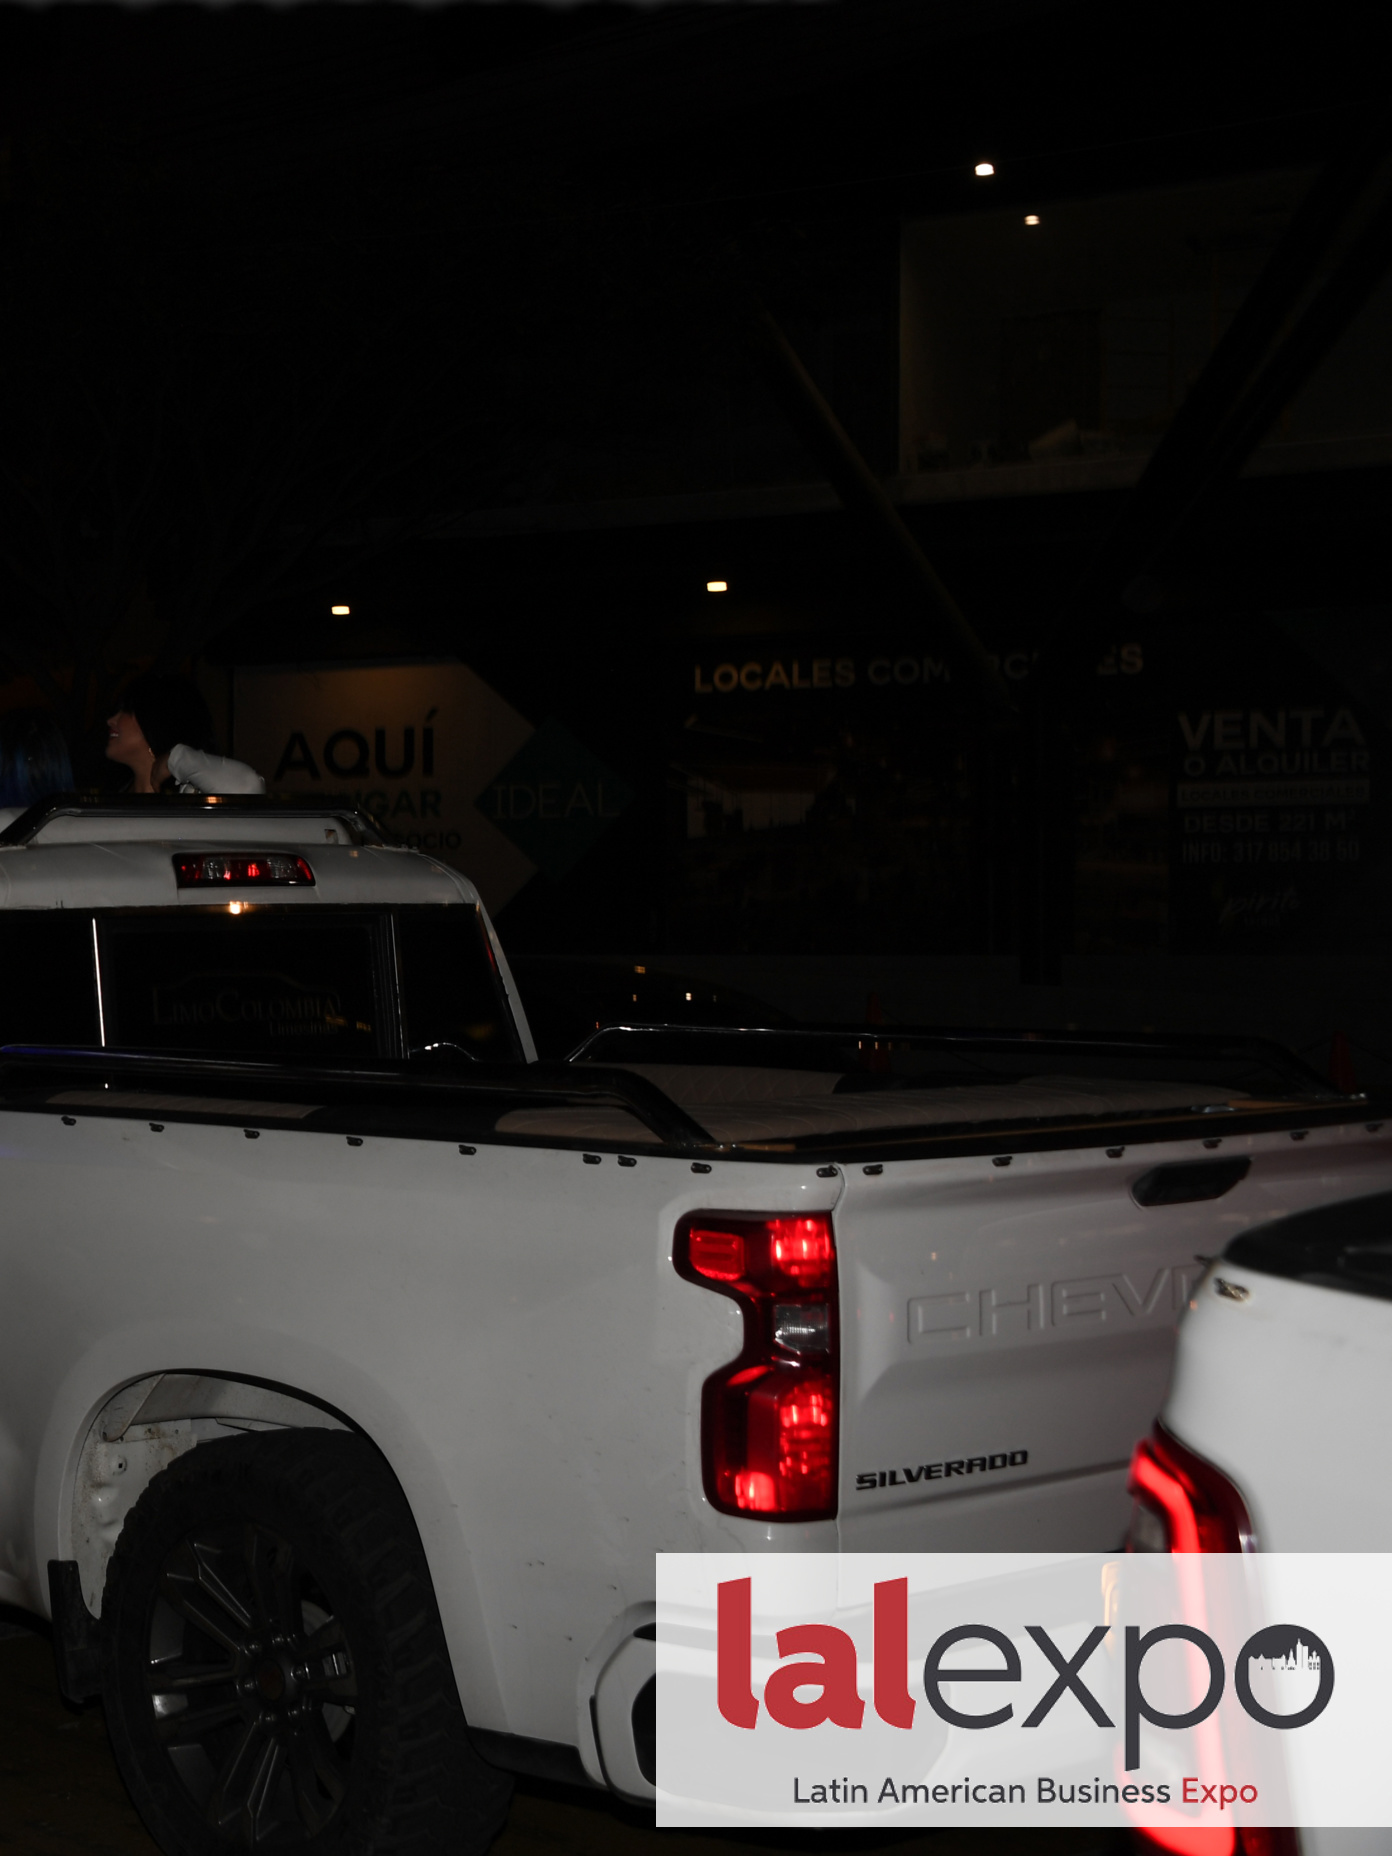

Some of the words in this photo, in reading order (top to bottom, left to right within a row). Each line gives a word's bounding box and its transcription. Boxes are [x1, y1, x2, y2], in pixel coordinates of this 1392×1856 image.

[694, 657, 857, 694] LOCALES
[275, 708, 437, 782] AQUÍ
[1177, 706, 1367, 750] VENTA
[1183, 754, 1206, 777] O
[1215, 750, 1370, 777] ALQUILER
[494, 783, 622, 820] IDEAL
[1184, 813, 1270, 834] DESDE
[1279, 811, 1315, 832] 221
[1182, 839, 1228, 864] INFO:
[855, 1450, 1028, 1491] SILVERADO
